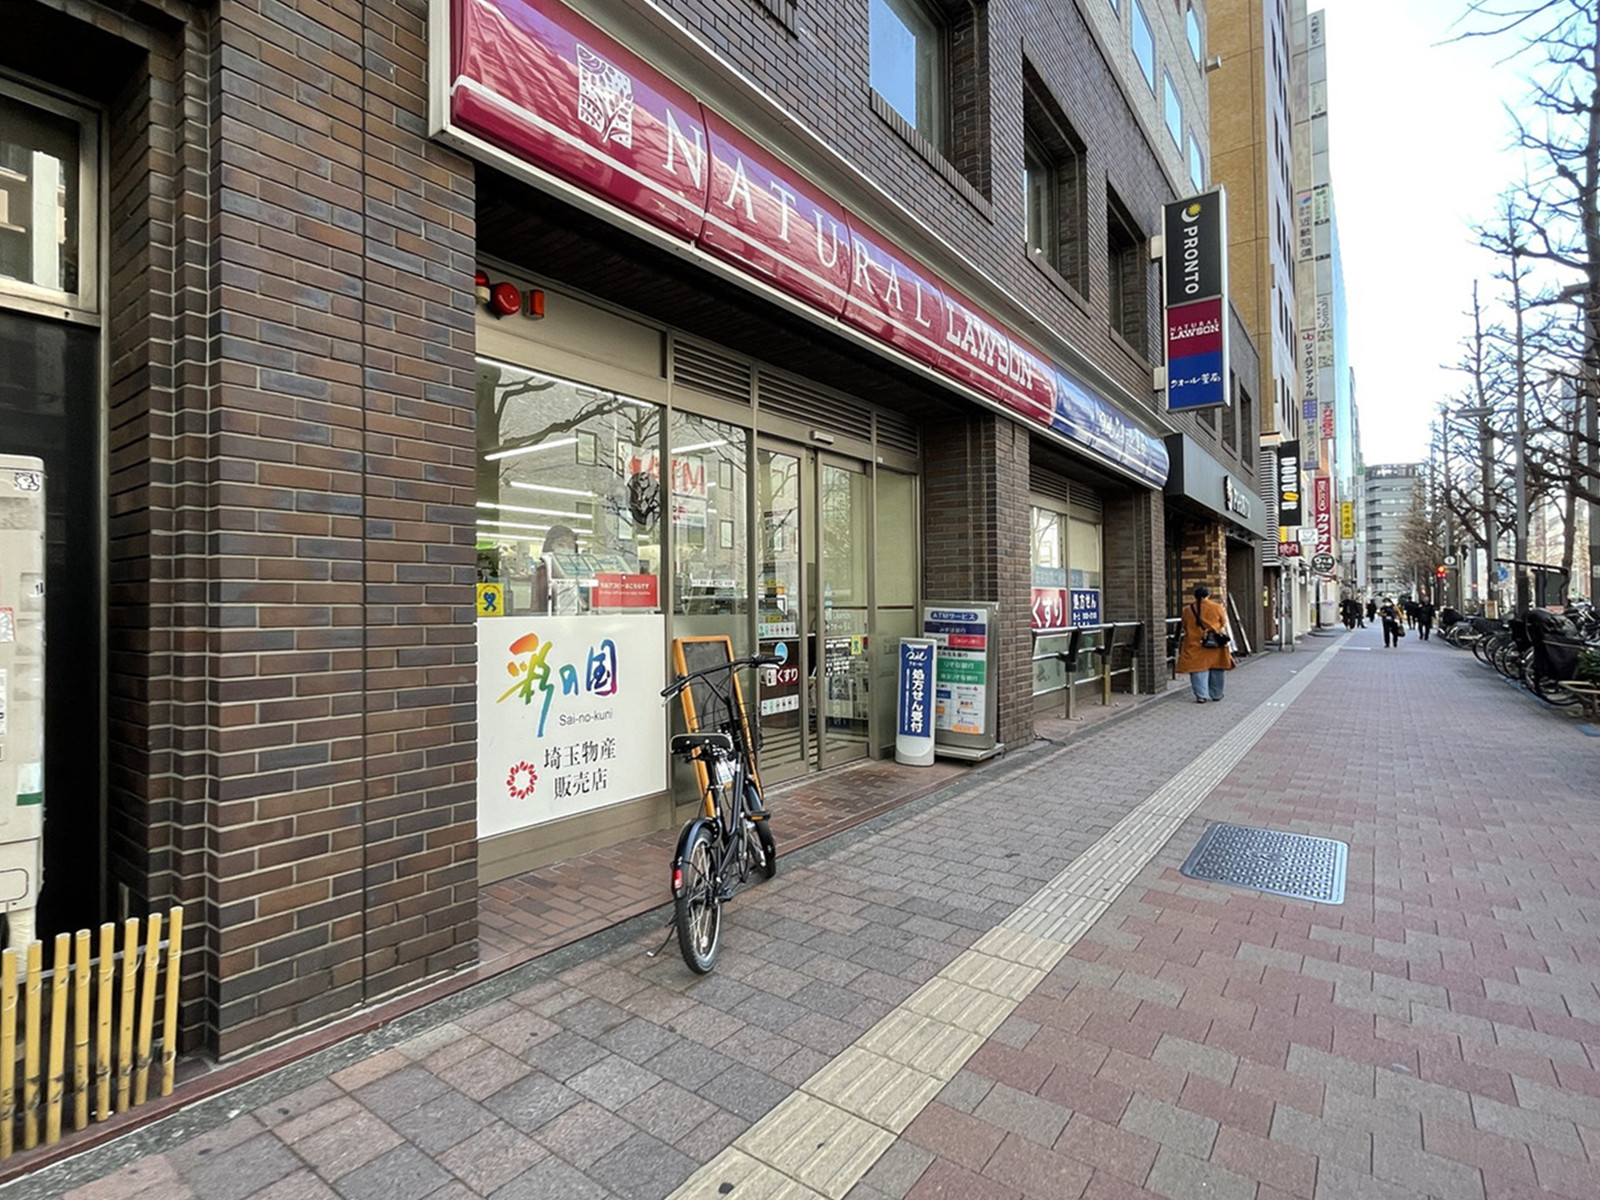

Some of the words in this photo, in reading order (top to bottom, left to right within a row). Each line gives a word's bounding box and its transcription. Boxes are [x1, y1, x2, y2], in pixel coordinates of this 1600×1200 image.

[663, 107, 931, 327] NATURAL
[945, 301, 1034, 390] LAWSON
[1183, 225, 1199, 295] PRONTO
[1169, 318, 1219, 332] NATURAL
[1169, 324, 1219, 340] LAWSON
[1280, 456, 1299, 511] DOUTOR
[1316, 513, 1330, 553] カラオケ
[1032, 596, 1063, 628] くすり
[497, 632, 618, 738] 彩の国
[777, 668, 798, 683] くすり
[910, 668, 926, 733] 処方せん受付
[559, 709, 613, 727] Sai-no-kuni
[543, 737, 616, 770] 埼玉物産
[554, 767, 608, 800] 販売店
